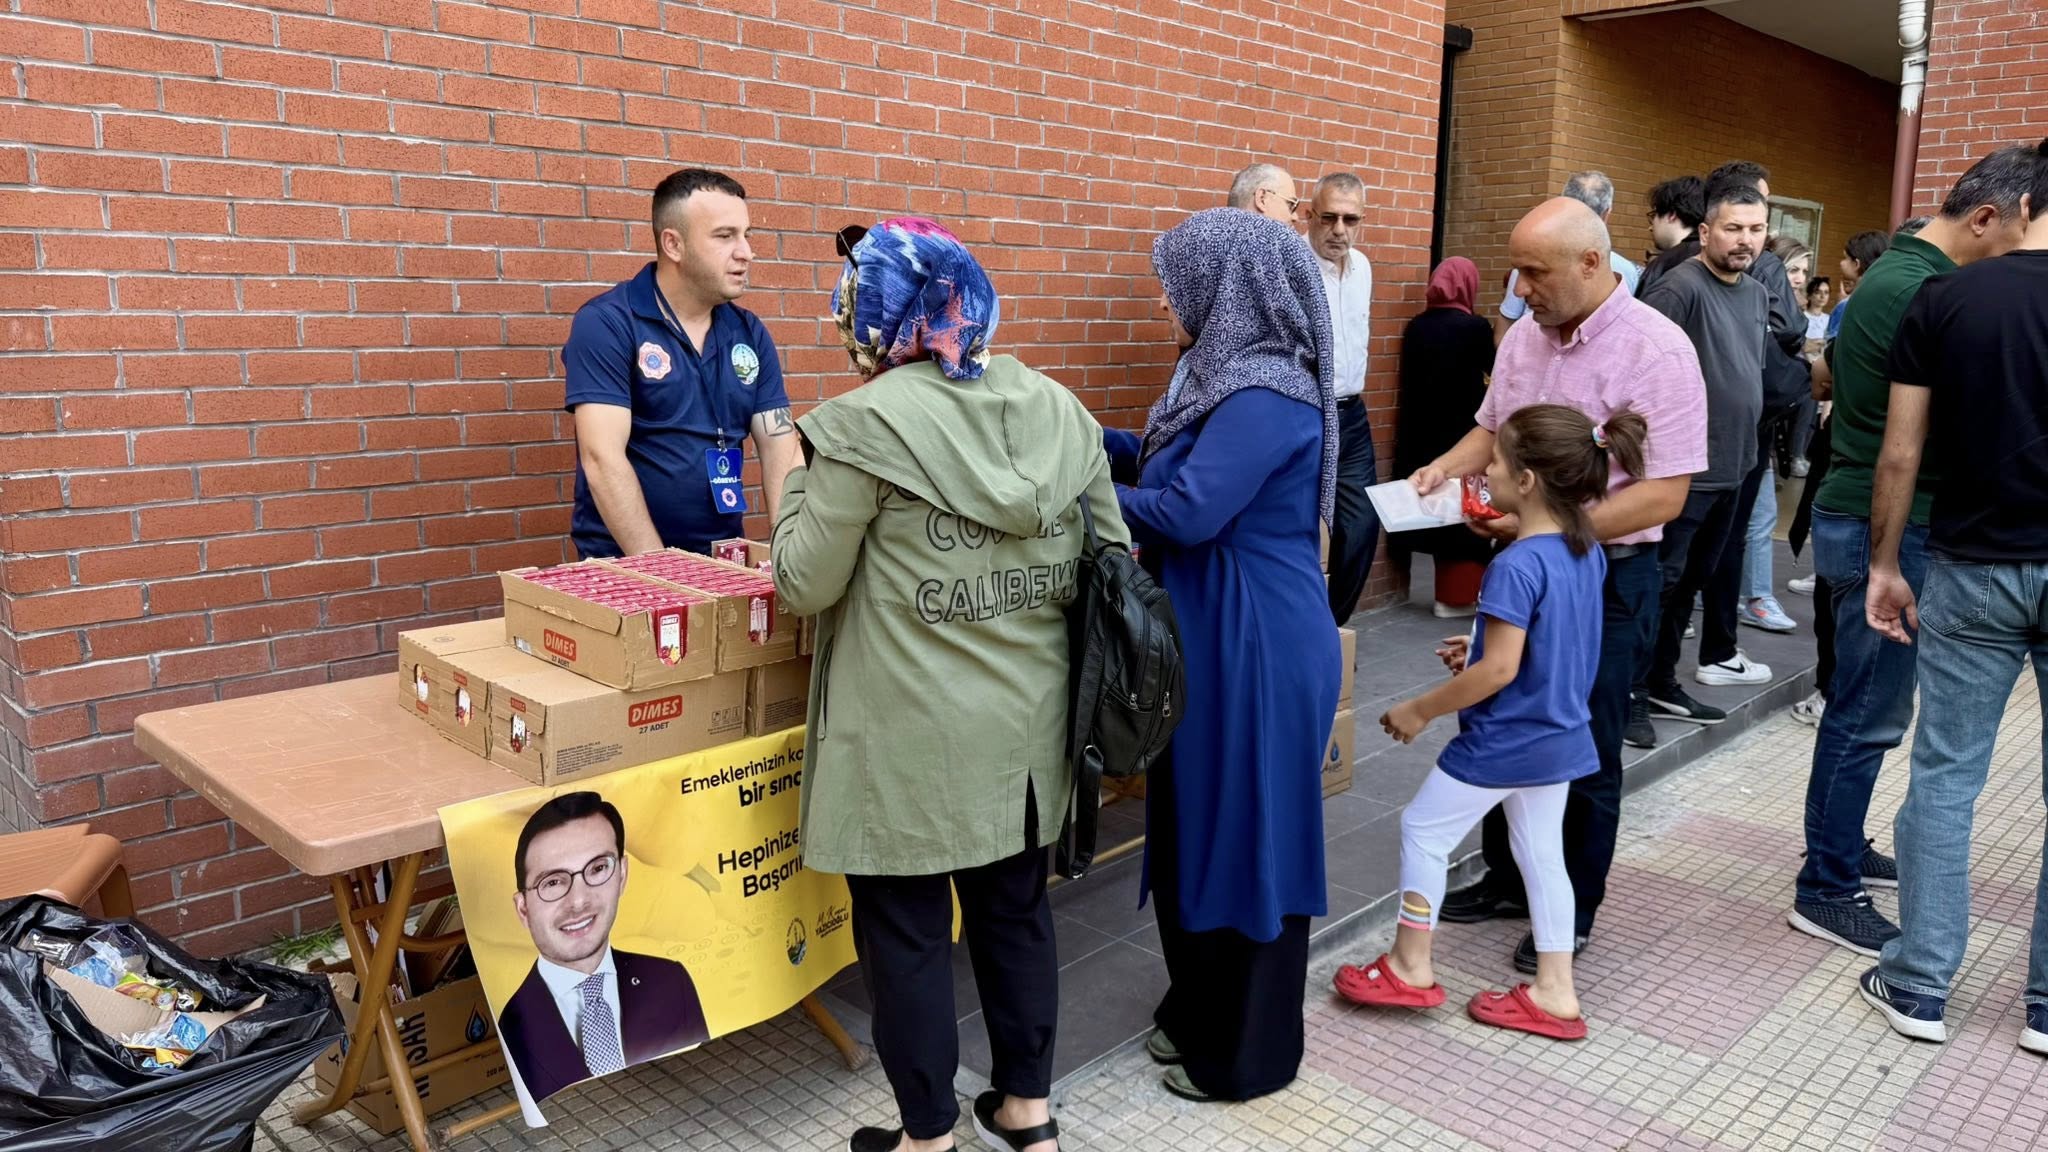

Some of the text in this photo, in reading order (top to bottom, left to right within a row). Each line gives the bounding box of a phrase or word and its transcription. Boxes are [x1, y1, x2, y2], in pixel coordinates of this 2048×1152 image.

[639, 721, 670, 734] 27 ADET
[681, 753, 785, 794] Emeklerinizin
[738, 784, 765, 807] bir
[718, 827, 799, 874] Hepinize
